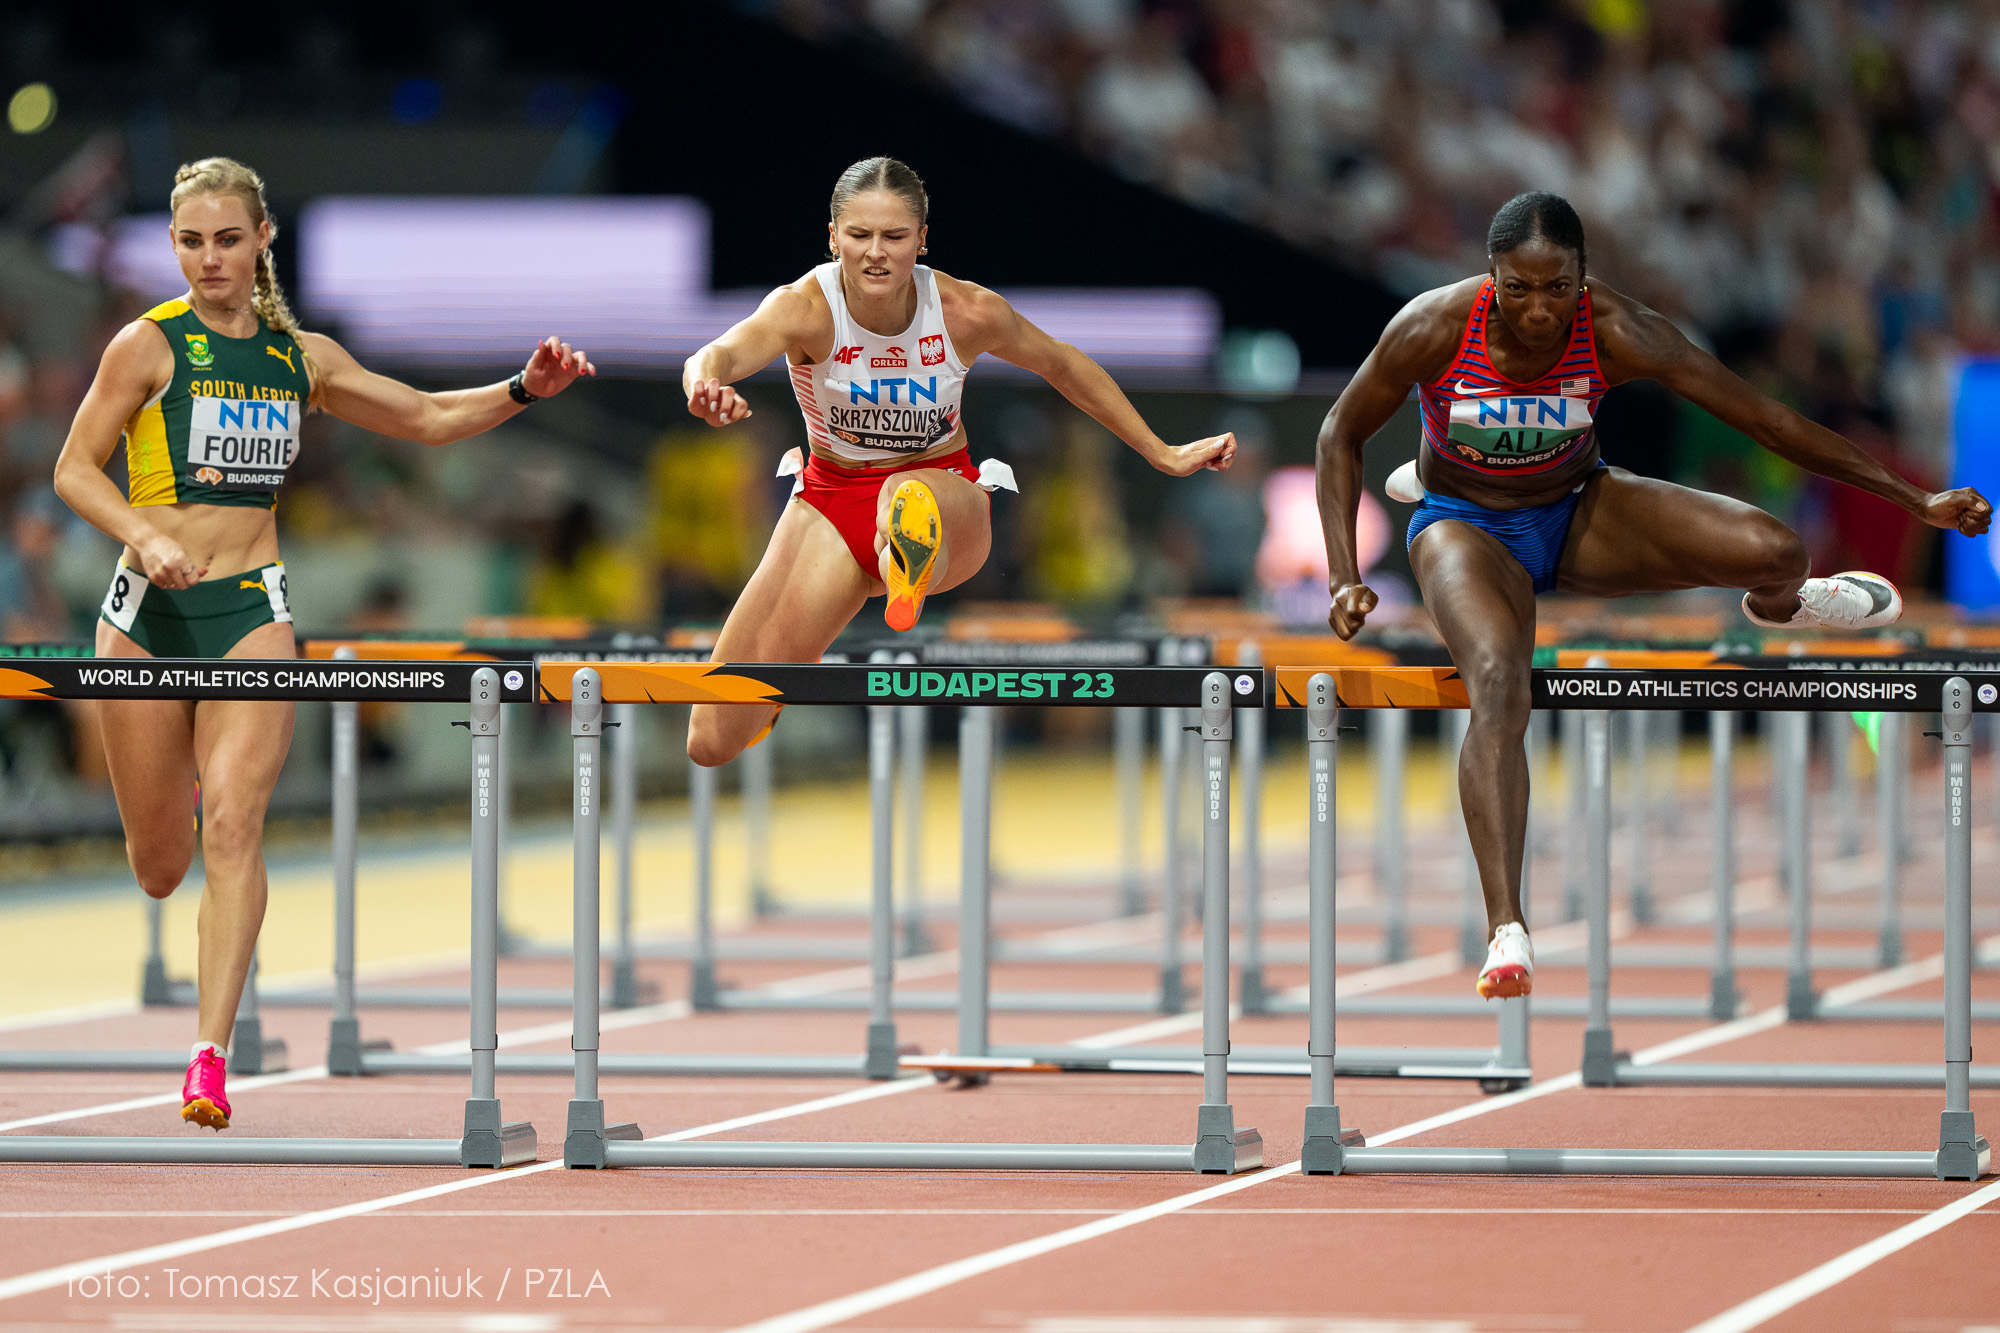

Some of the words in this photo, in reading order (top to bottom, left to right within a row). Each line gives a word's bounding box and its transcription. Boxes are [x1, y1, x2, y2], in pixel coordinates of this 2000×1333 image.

[872, 358, 905, 367] ORLEN
[190, 380, 246, 400] SOUTH
[850, 376, 937, 406] NTN
[218, 400, 289, 431] NTN
[1478, 397, 1567, 428] NTN
[203, 435, 293, 465] FOURIE
[864, 437, 929, 449] BUDAPES
[1487, 450, 1558, 465] BUDAPEST
[1558, 439, 1571, 451] 23
[1492, 430, 1543, 453] ALI
[227, 473, 285, 485] BUDAPEST
[111, 574, 130, 613] 8
[78, 669, 154, 686] WORLD
[158, 670, 269, 688] ATHLETICS
[274, 671, 445, 688] CHAMPIONSHIPS
[867, 671, 1067, 698] BUDAPEST
[1072, 672, 1115, 698] 23
[1546, 679, 1622, 696] WORLD
[1626, 680, 1739, 698] ATHLETICS
[1743, 681, 1917, 700] CHAMPIONSHIPS
[477, 768, 490, 817] MONDO
[579, 767, 592, 816] MONDO
[1209, 770, 1222, 820] MONDO
[1315, 773, 1328, 822] MONDO
[1950, 776, 1963, 827] MONDO
